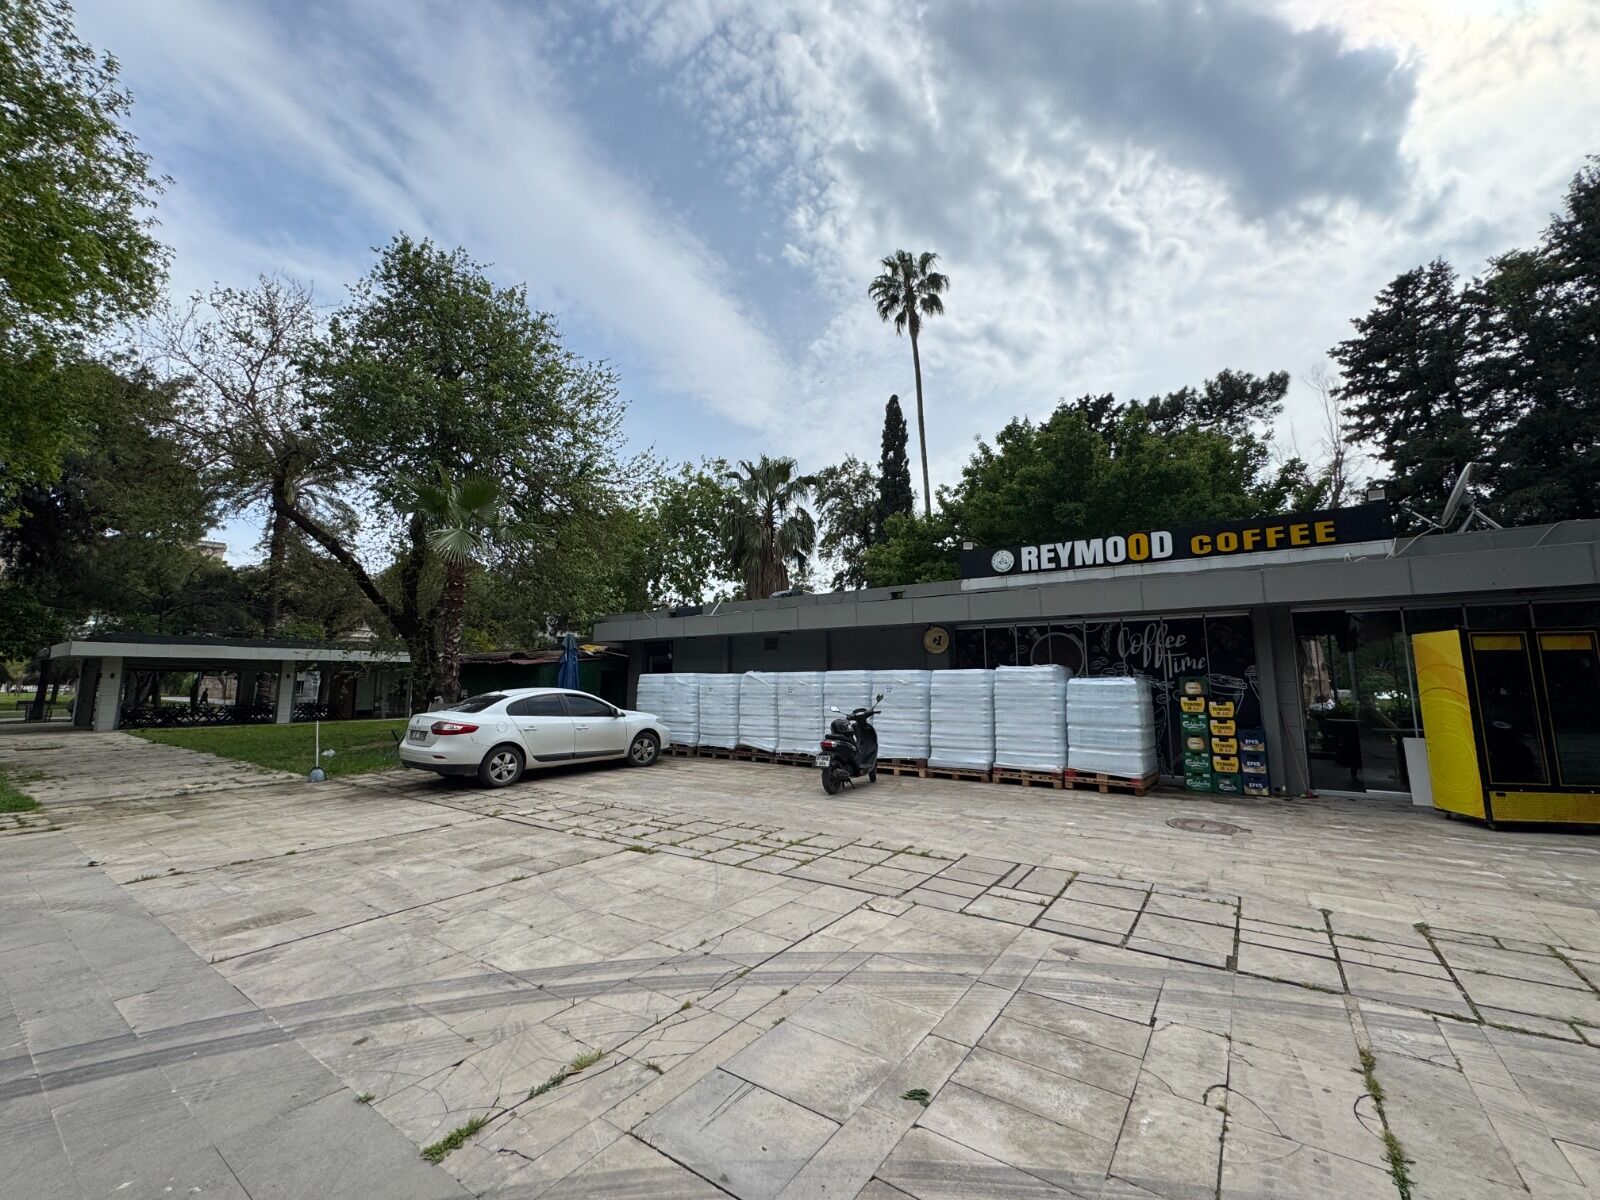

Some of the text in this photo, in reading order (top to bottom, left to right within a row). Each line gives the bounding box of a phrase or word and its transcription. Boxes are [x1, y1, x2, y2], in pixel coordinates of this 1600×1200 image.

[1020, 530, 1174, 572] REYMOOD
[1190, 520, 1337, 556] COFFEE
[1117, 623, 1187, 669] Coffee
